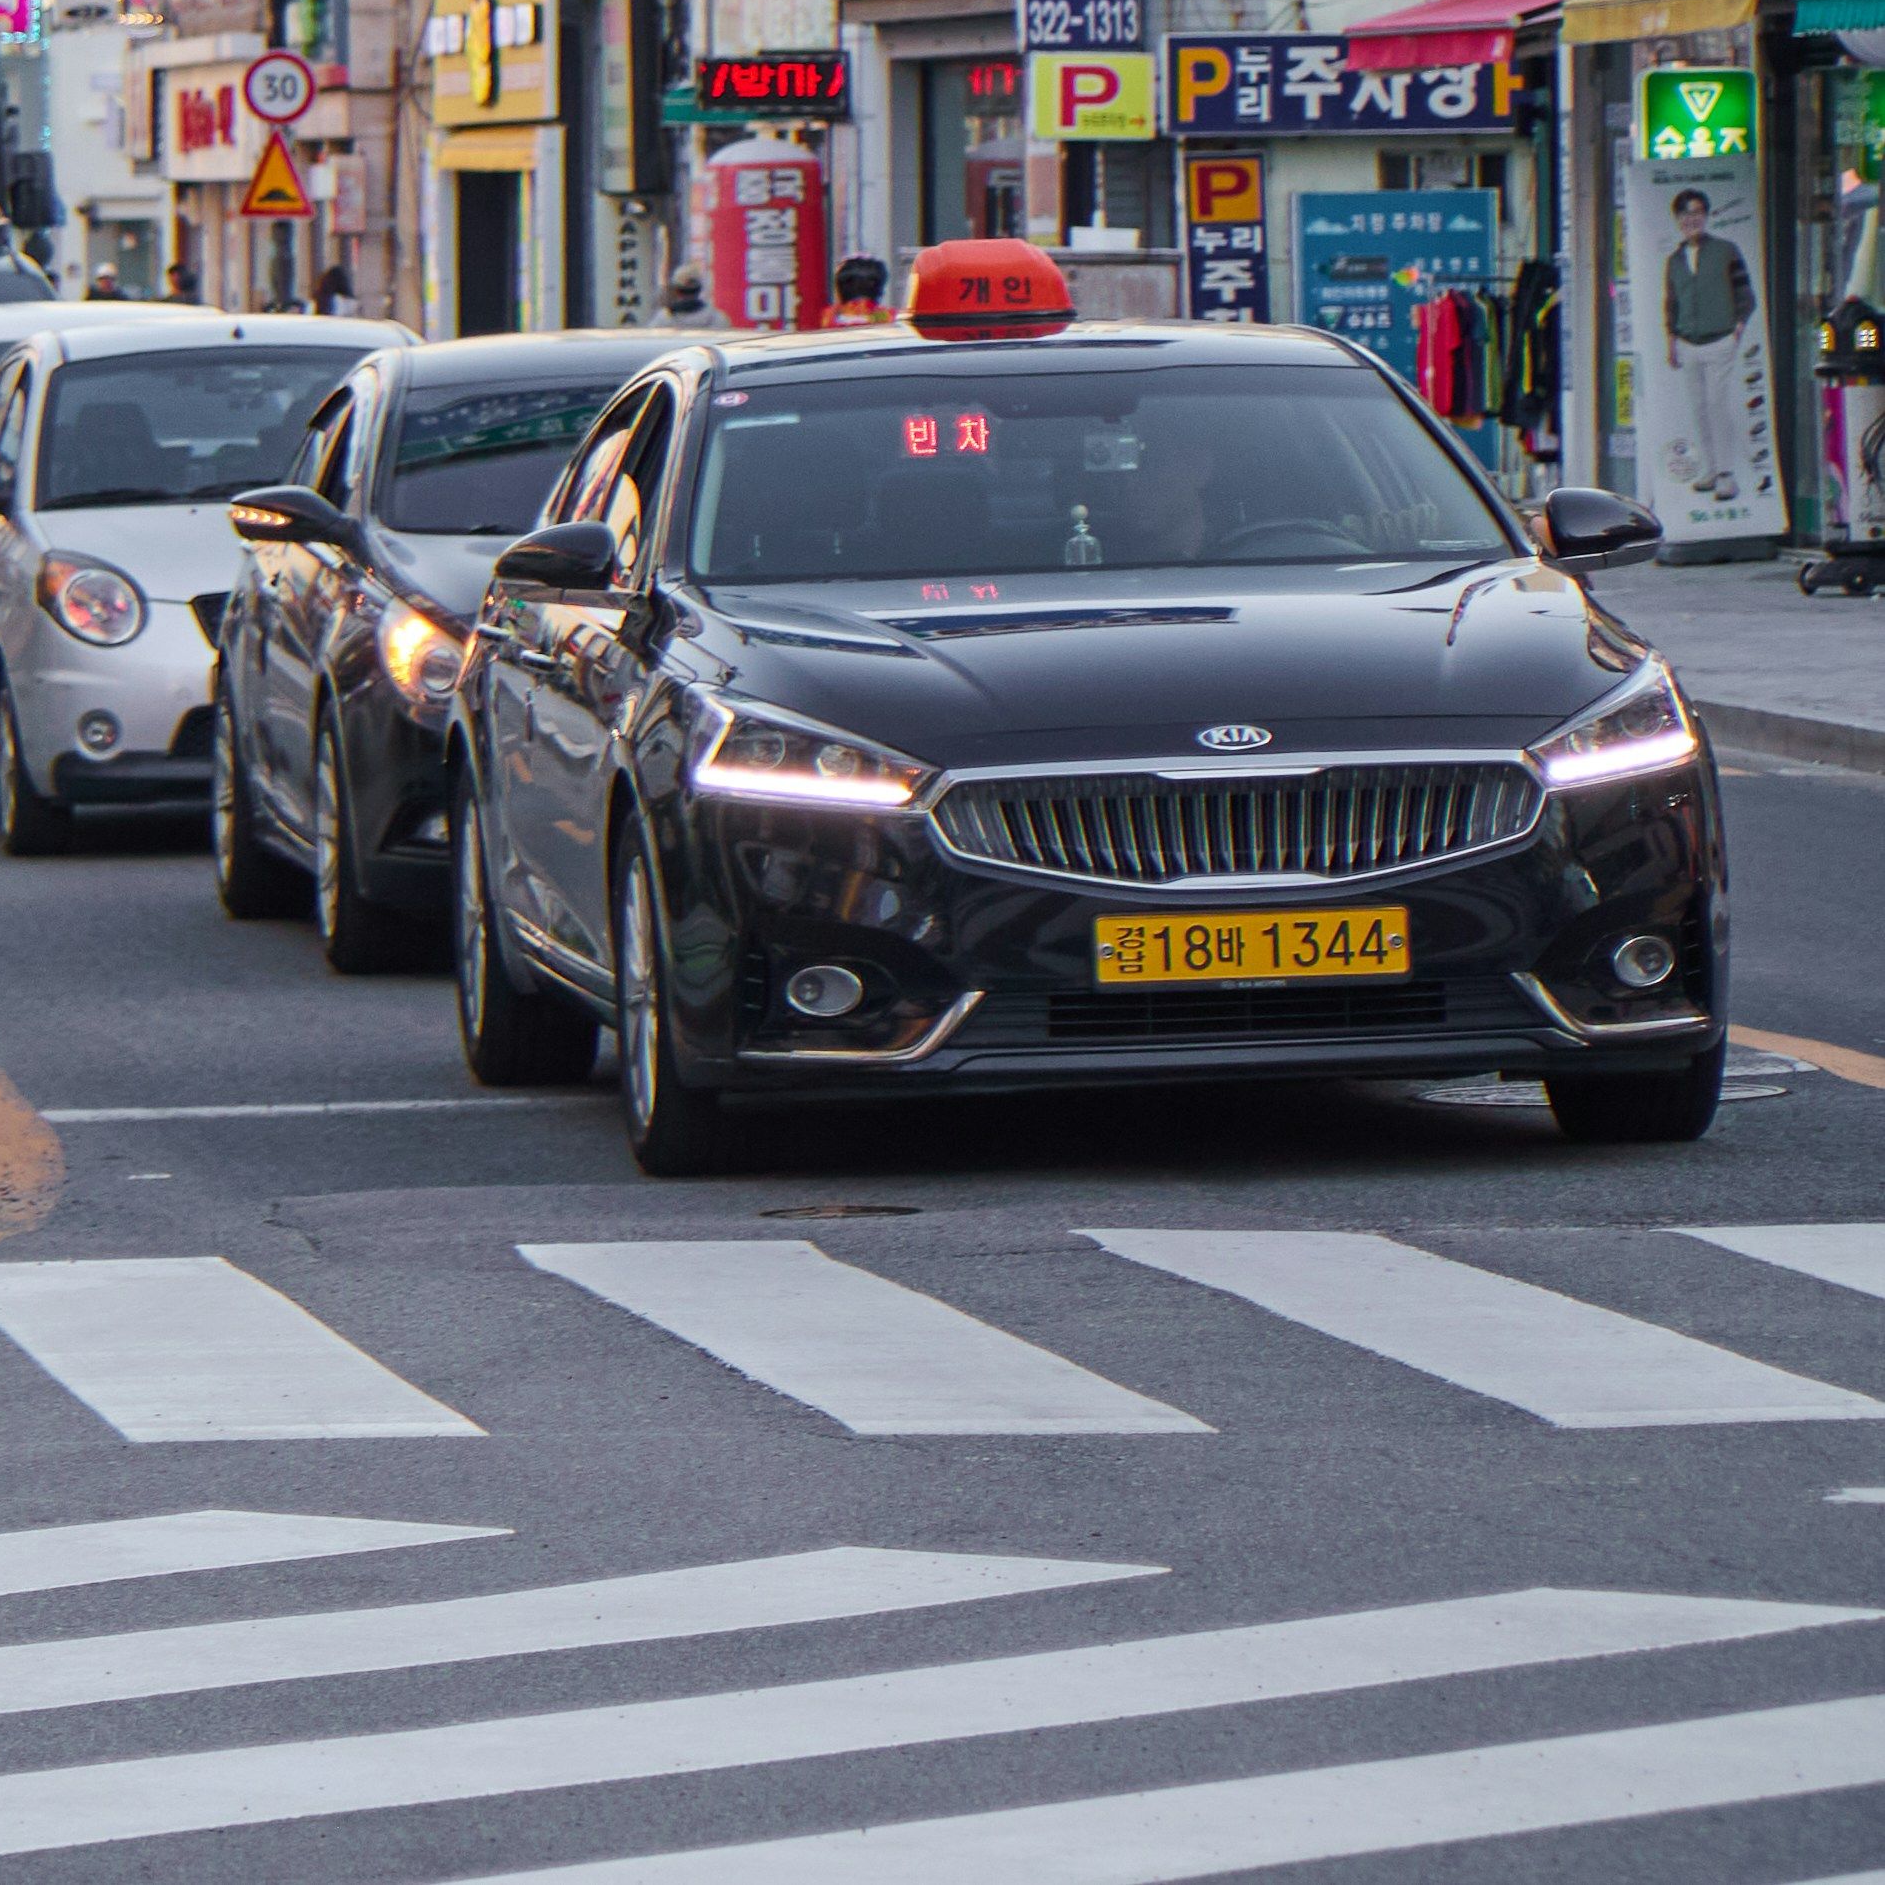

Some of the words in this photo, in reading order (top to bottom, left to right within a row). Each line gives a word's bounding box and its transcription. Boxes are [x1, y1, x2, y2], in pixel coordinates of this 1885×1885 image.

[1029, 0, 1139, 44] 322-1313
[263, 73, 299, 102] 30
[1059, 66, 1120, 128] P
[1177, 46, 1231, 122] P
[1235, 45, 1273, 123] 누리
[1196, 166, 1252, 218] P
[1193, 225, 1264, 255] 누리
[958, 276, 1033, 305] 개인
[1211, 727, 1263, 745] KIA
[1152, 923, 1246, 973] 18바
[1260, 917, 1389, 970] 1344
